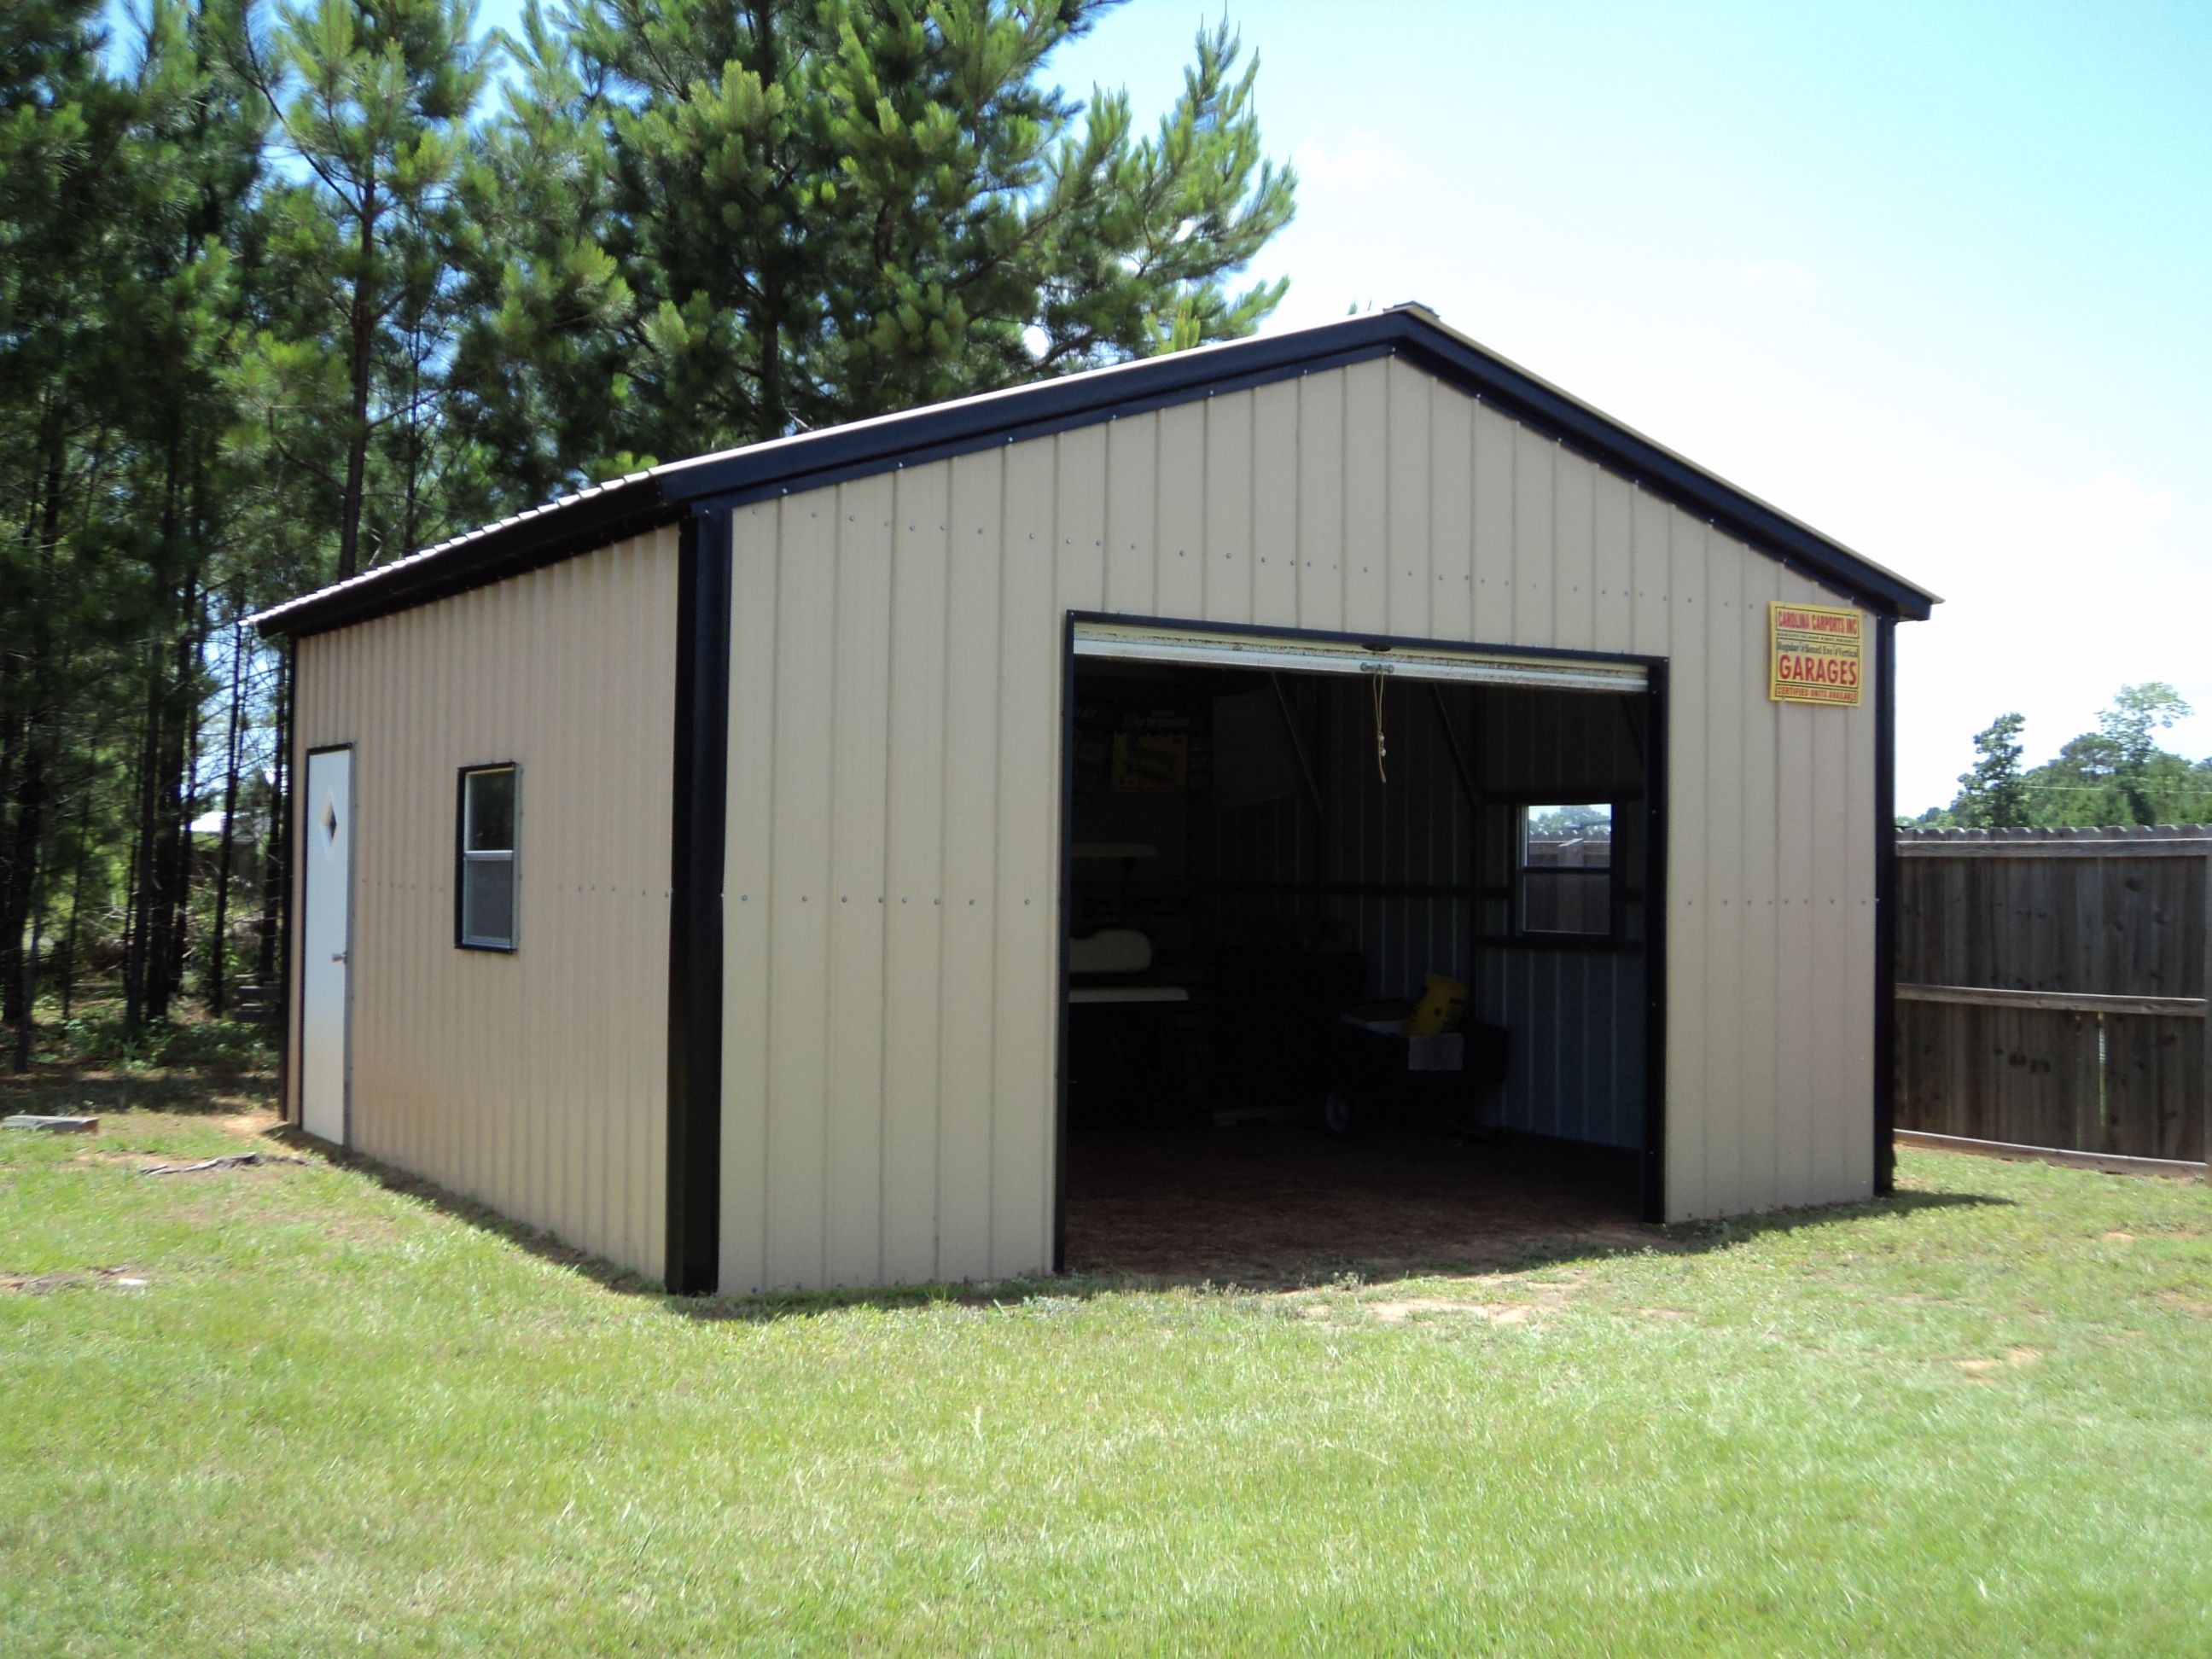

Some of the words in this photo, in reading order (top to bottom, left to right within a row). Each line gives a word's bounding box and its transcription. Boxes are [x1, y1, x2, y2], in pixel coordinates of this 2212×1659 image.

[1778, 611, 1808, 628] CAROLINA
[1813, 614, 1844, 633] CARPORTS
[1779, 655, 1856, 685] GARAGES
[1778, 687, 1808, 696] CERTIFIED
[1830, 691, 1857, 701] AVAILABLE
